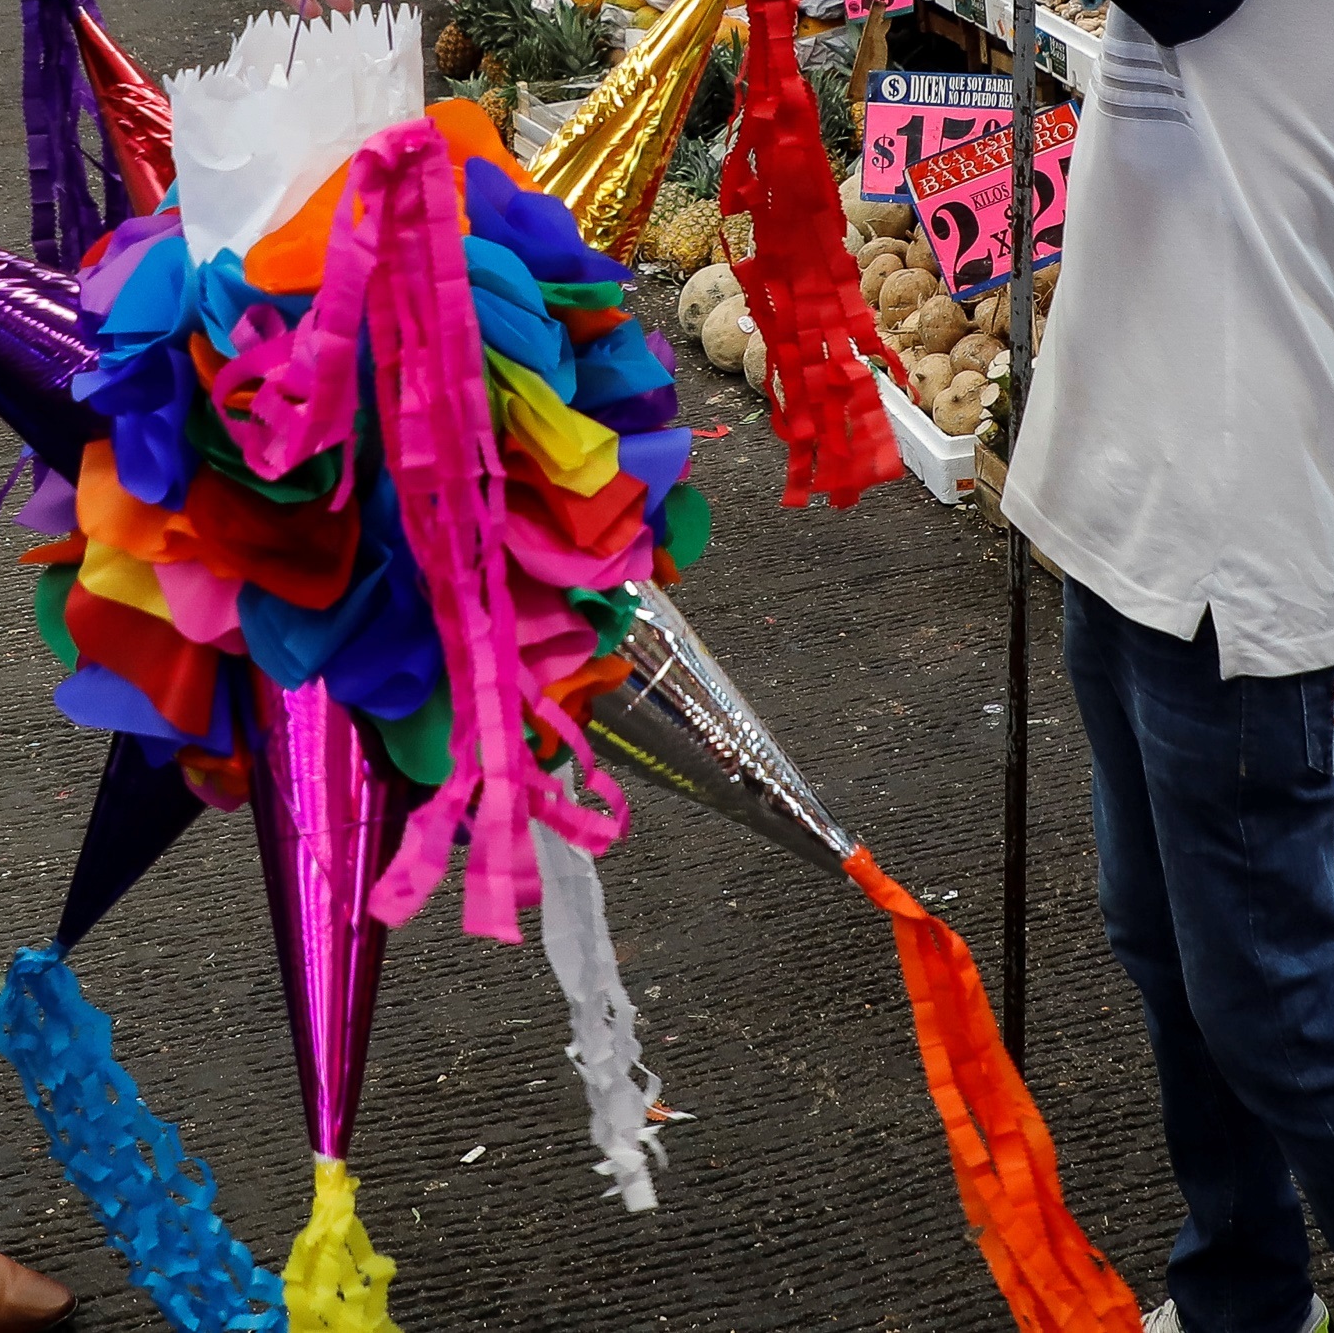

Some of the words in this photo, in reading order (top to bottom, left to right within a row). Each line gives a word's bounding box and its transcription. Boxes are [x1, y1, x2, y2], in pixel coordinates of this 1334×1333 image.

[909, 74, 947, 104] DICEN
[948, 92, 959, 105] NO
[960, 92, 971, 106] LO
[971, 92, 997, 107] PUEDO
[949, 76, 966, 90] QUE
[967, 77, 985, 92] SOY
[985, 78, 1014, 94] BARAT
[919, 121, 1075, 196] BARATRO
[926, 150, 966, 175] ACA
[972, 128, 1015, 156] EST
[971, 184, 1011, 210] KILOS
[931, 201, 993, 293] 2
